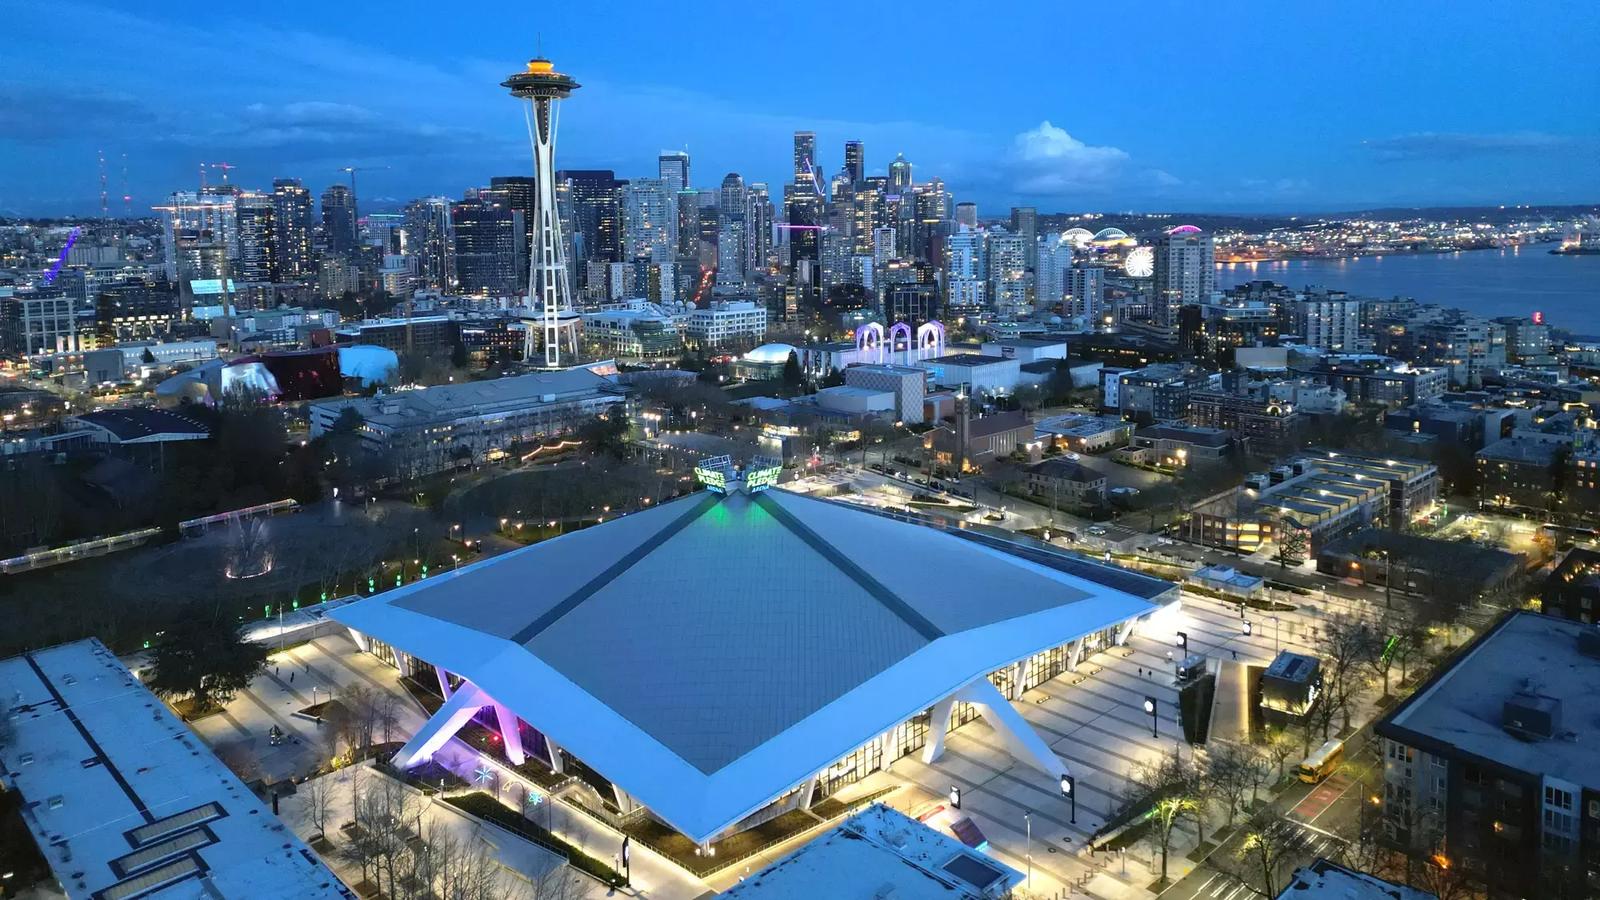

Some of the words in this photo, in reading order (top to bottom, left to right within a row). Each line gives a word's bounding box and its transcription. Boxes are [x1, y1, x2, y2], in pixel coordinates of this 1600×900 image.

[694, 467, 724, 480] CLIMATE
[747, 466, 782, 480] CLIMATE
[697, 474, 725, 488] PLEDGE
[746, 475, 778, 488] PLEDGE
